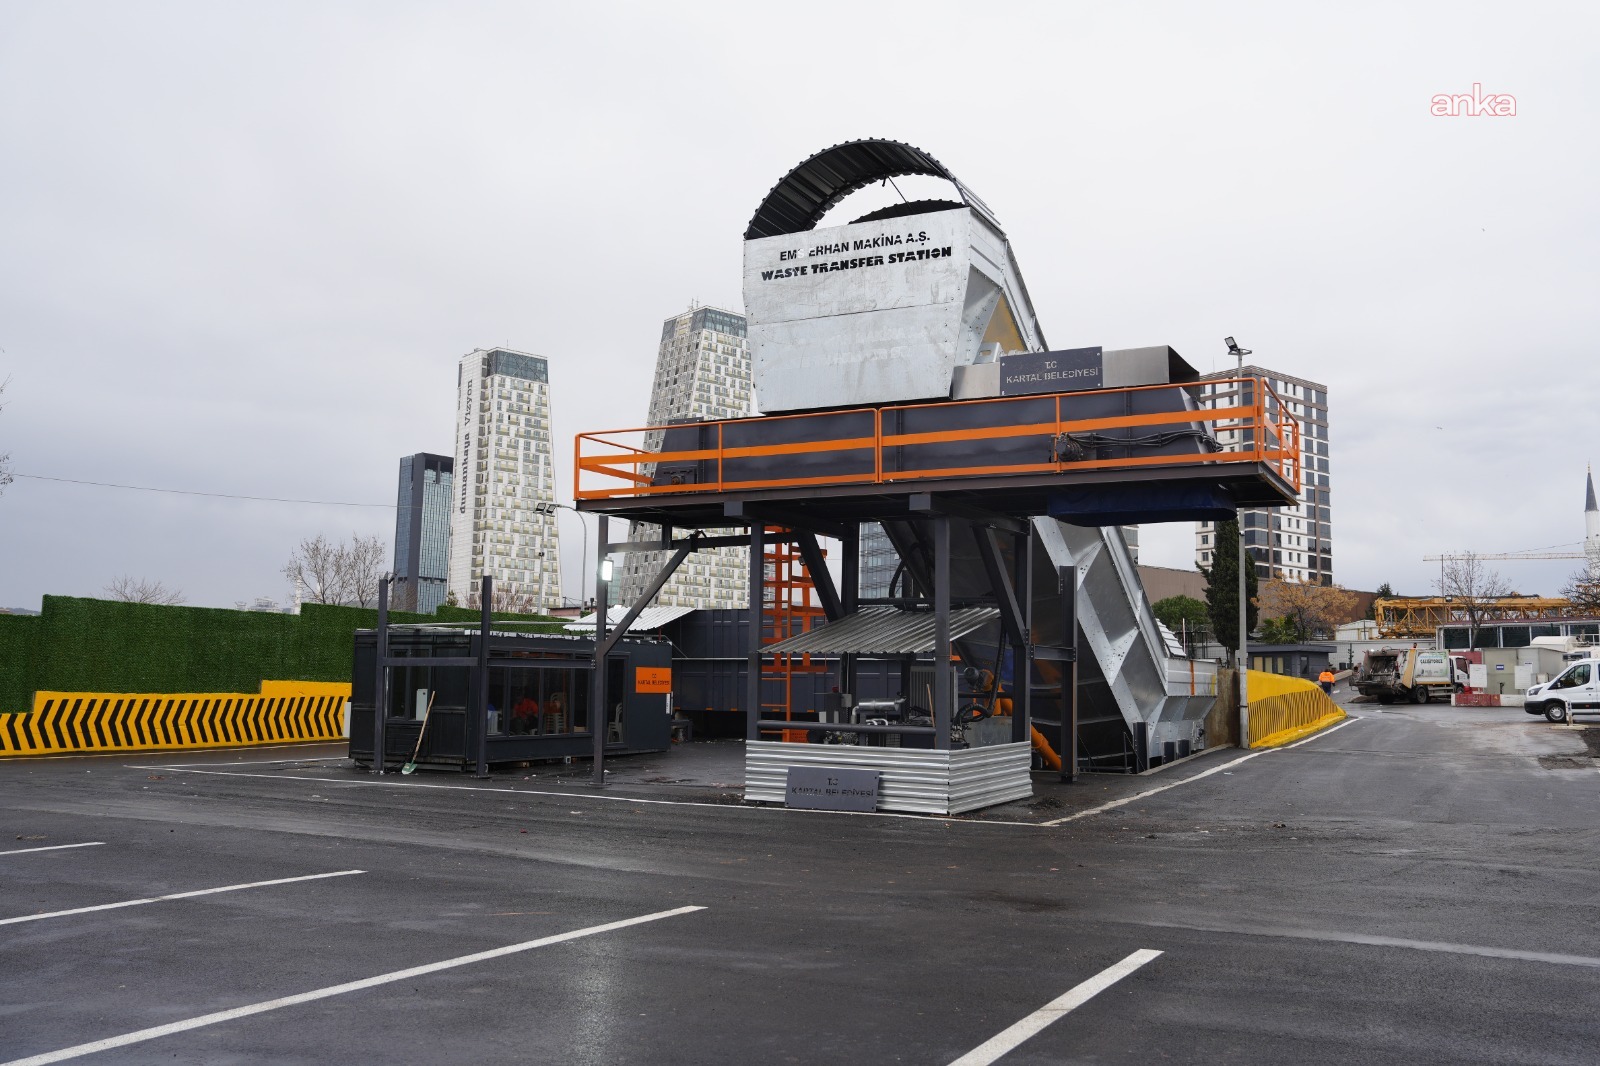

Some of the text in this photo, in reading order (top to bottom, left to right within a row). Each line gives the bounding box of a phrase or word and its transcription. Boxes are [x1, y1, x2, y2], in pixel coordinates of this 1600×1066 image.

[808, 241, 849, 258] ERHAN
[853, 233, 902, 251] MAKİNA
[906, 231, 930, 246] A.Ş.
[761, 246, 952, 281] WASTE TRANSFER STATION
[1006, 367, 1098, 384] KARTAL BELEDİYESİ
[460, 433, 470, 514] dumankaya
